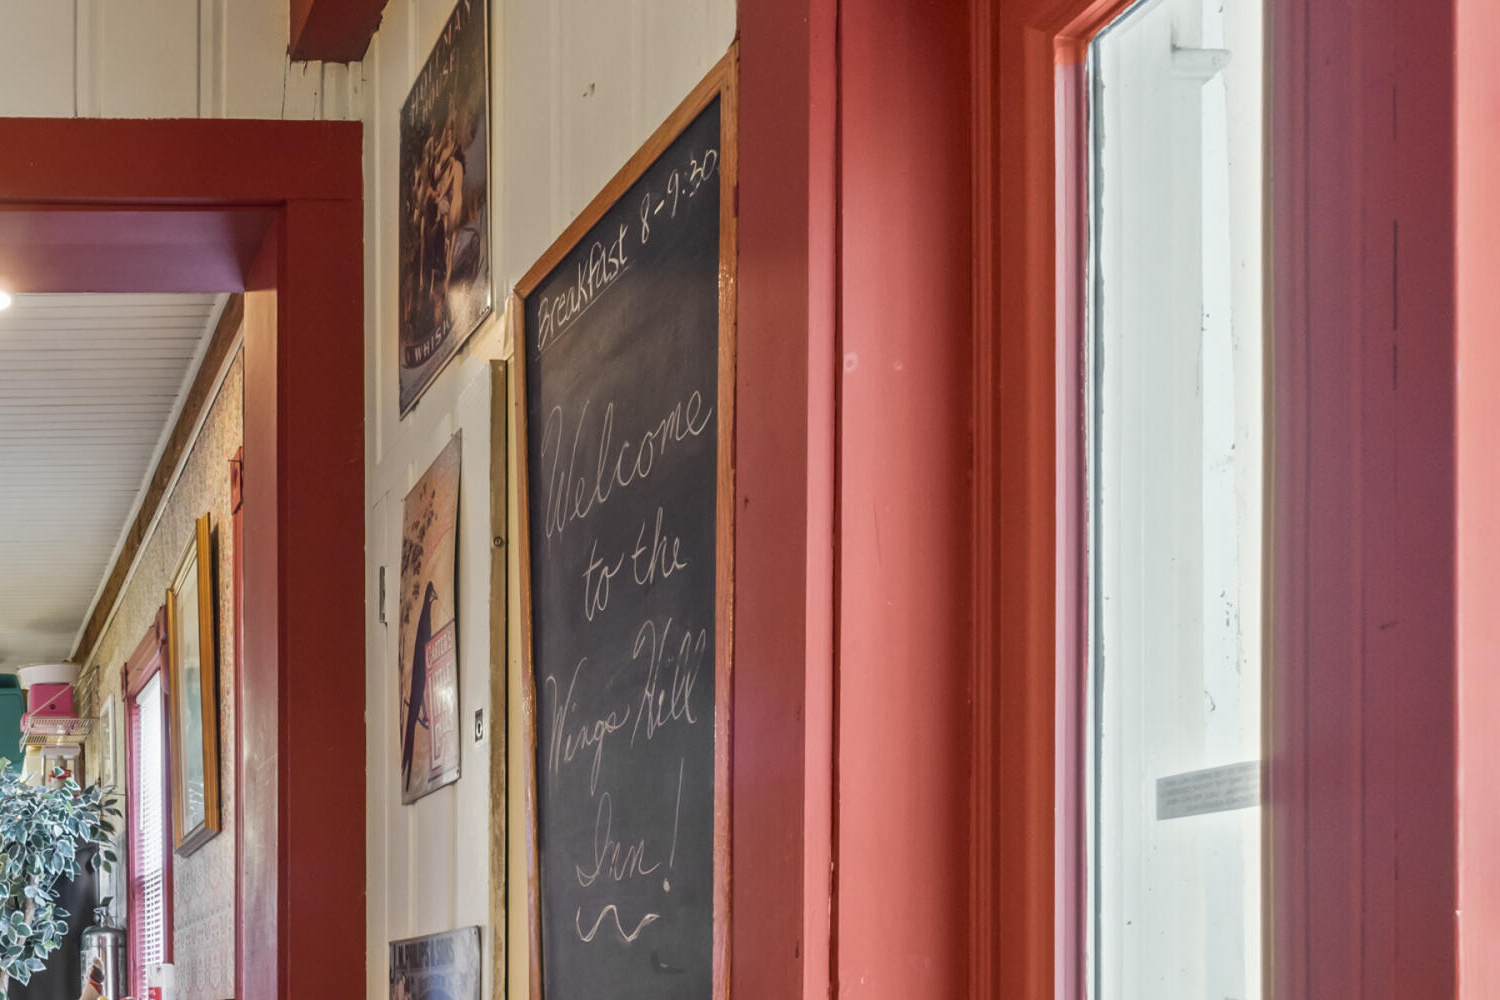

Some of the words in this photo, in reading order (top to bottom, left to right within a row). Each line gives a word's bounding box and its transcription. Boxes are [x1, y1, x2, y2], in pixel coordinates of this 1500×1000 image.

[537, 223, 629, 351] Breakfast
[540, 389, 713, 540] Welcome
[581, 538, 626, 622] to
[631, 506, 688, 585] the
[546, 656, 631, 797] Wings
[630, 617, 707, 748] Hill
